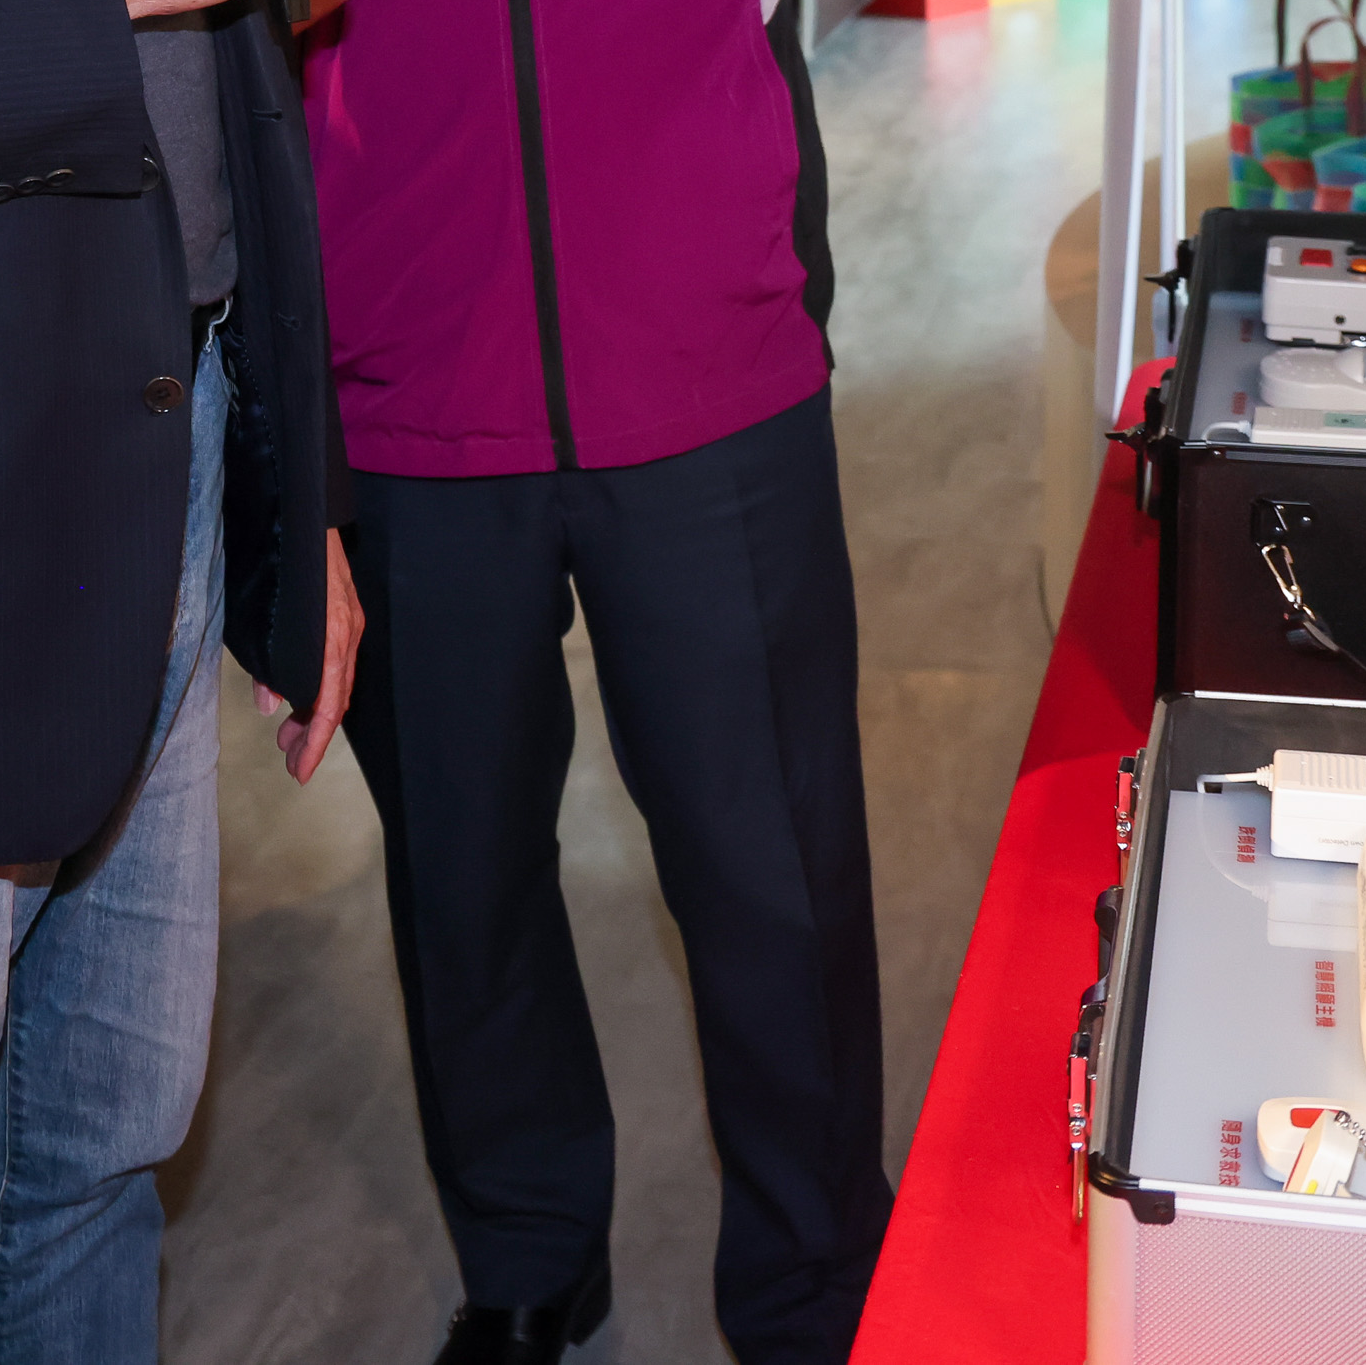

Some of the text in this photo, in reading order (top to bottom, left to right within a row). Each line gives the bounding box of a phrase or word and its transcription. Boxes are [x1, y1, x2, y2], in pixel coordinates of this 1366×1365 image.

[1315, 960, 1336, 1028] 智慧照顧主機
